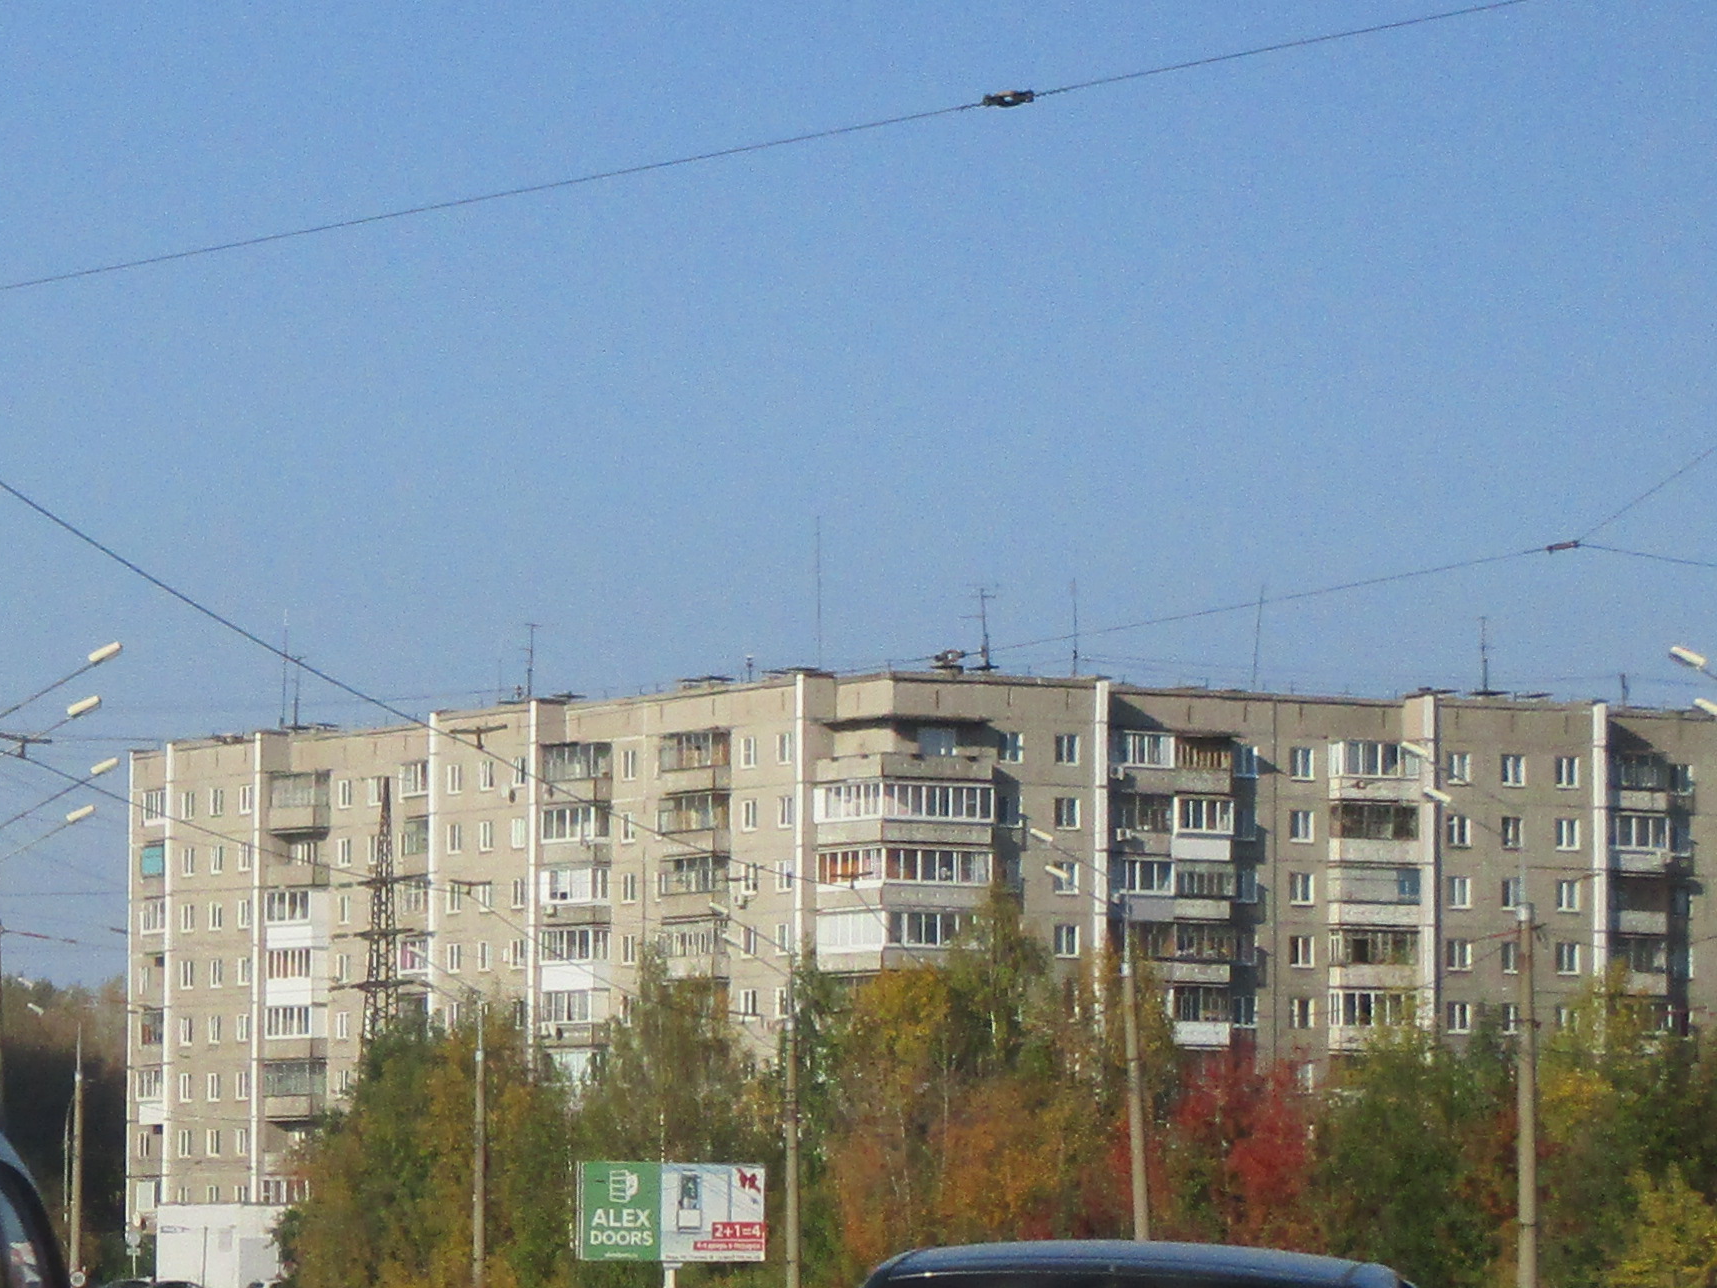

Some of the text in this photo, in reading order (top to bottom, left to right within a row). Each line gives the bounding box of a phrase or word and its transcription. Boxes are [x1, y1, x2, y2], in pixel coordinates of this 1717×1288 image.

[591, 1208, 652, 1228] ALEX
[590, 1229, 654, 1247] DOORS
[714, 1223, 761, 1238] 2+1=4
